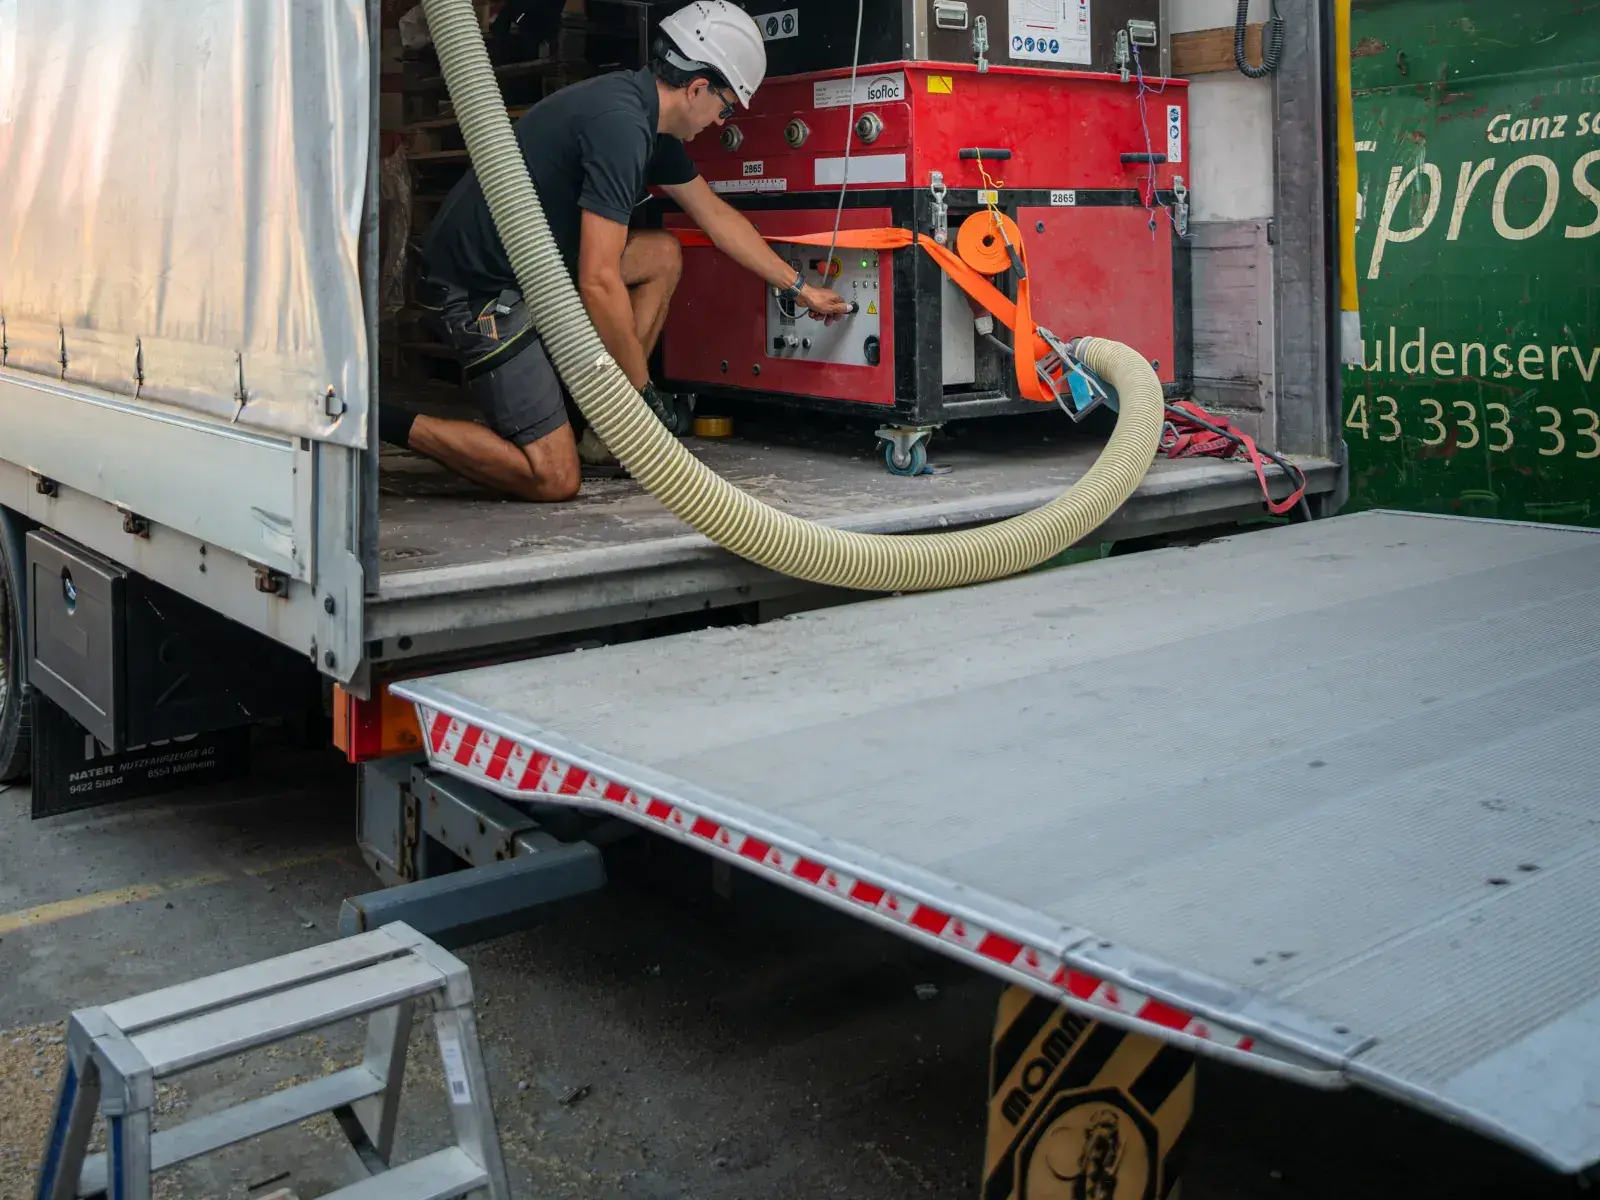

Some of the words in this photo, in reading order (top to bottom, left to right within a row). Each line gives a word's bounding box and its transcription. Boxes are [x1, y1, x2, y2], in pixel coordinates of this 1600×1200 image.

[867, 84, 899, 100] isofloc
[1487, 113, 1568, 144] Ganz
[744, 164, 762, 174] 2865
[1052, 193, 1074, 203] 2865
[1347, 326, 1600, 383] uldenserv
[1419, 398, 1514, 453] 333
[1535, 405, 1600, 460] 33
[69, 765, 115, 782] NATER
[201, 746, 216, 757] AG
[69, 782, 93, 795] 9422
